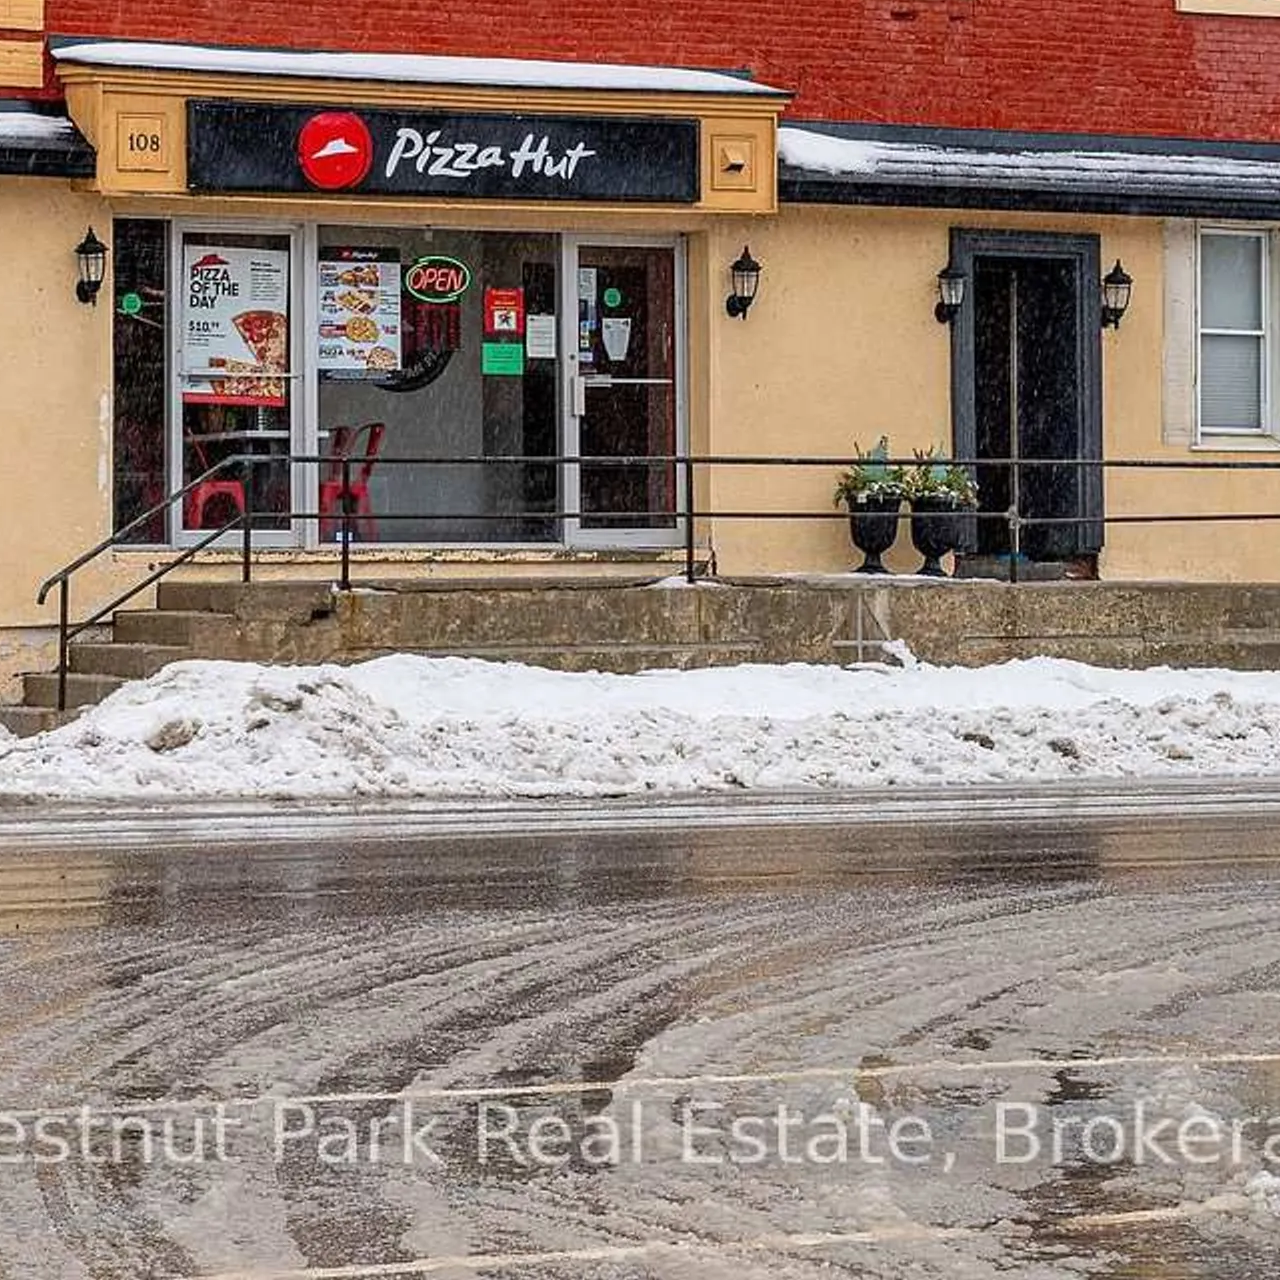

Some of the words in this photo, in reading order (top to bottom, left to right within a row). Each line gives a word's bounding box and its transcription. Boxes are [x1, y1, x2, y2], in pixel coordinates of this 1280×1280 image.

[129, 132, 160, 152] 108
[385, 127, 505, 178] Pizza
[510, 133, 596, 180] Hut
[190, 268, 231, 282] PIZZA
[410, 267, 463, 292] OPEN
[190, 282, 209, 295] OF
[214, 282, 240, 297] THE
[189, 295, 218, 309] DAY
